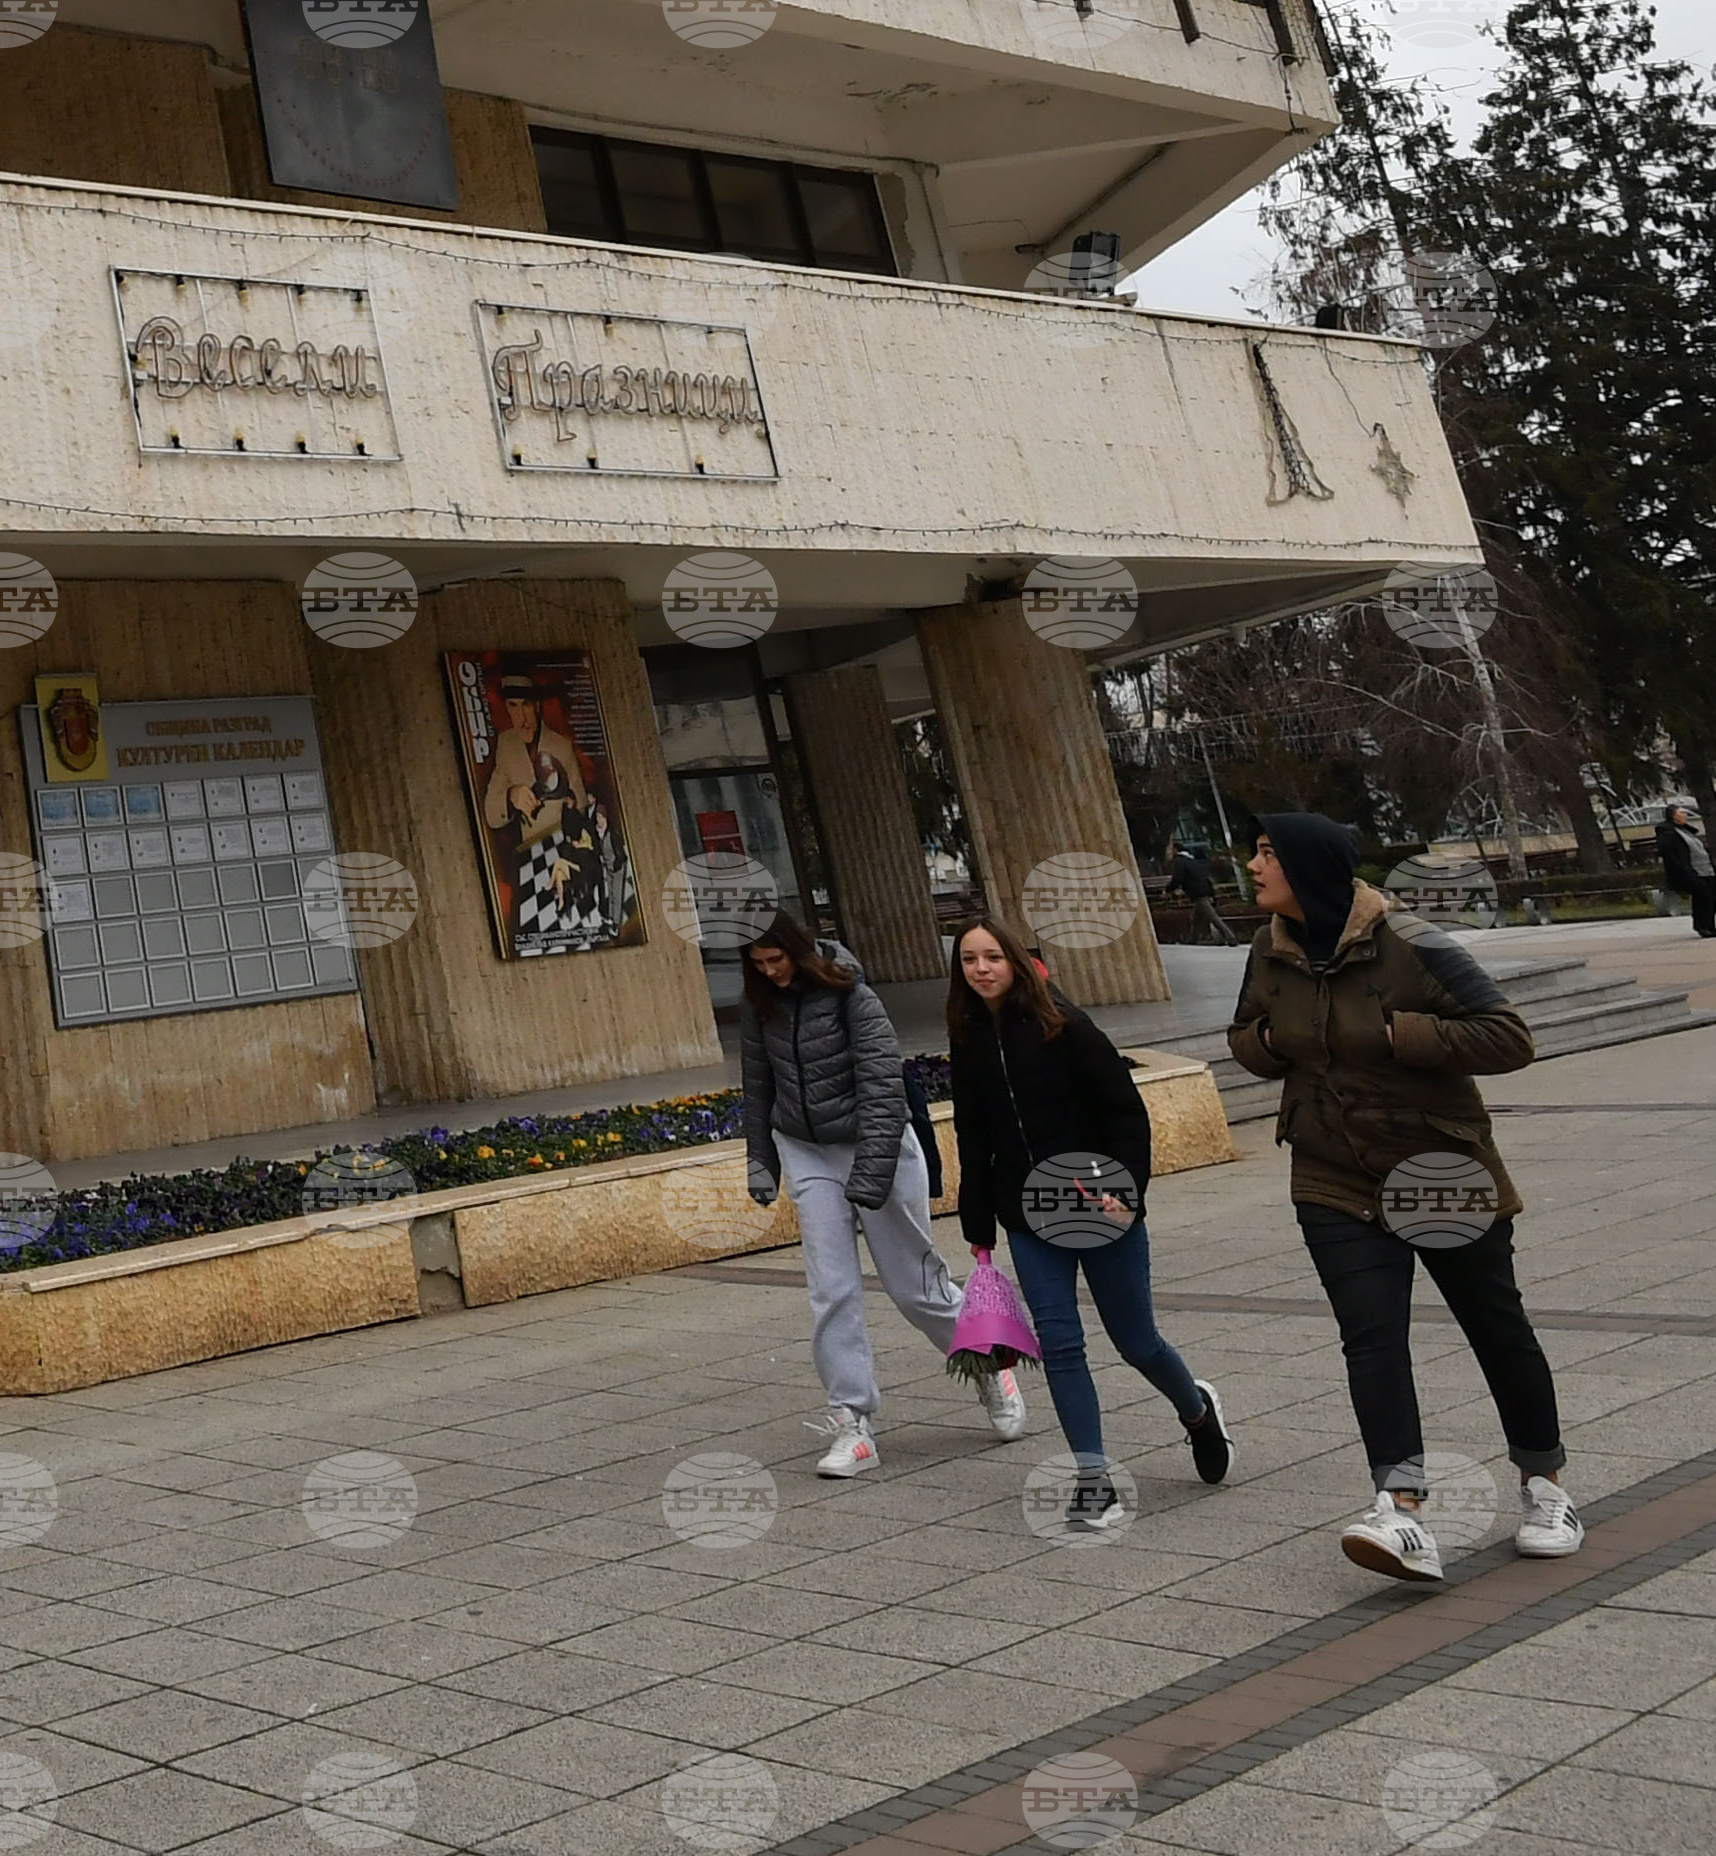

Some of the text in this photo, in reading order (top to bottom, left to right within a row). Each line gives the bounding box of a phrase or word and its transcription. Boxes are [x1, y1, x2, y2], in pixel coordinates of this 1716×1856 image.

[135, 316, 378, 399] Весели
[493, 330, 760, 442] Празници
[116, 738, 305, 767] КУЛТУРЕН КАЛЕНДАР
